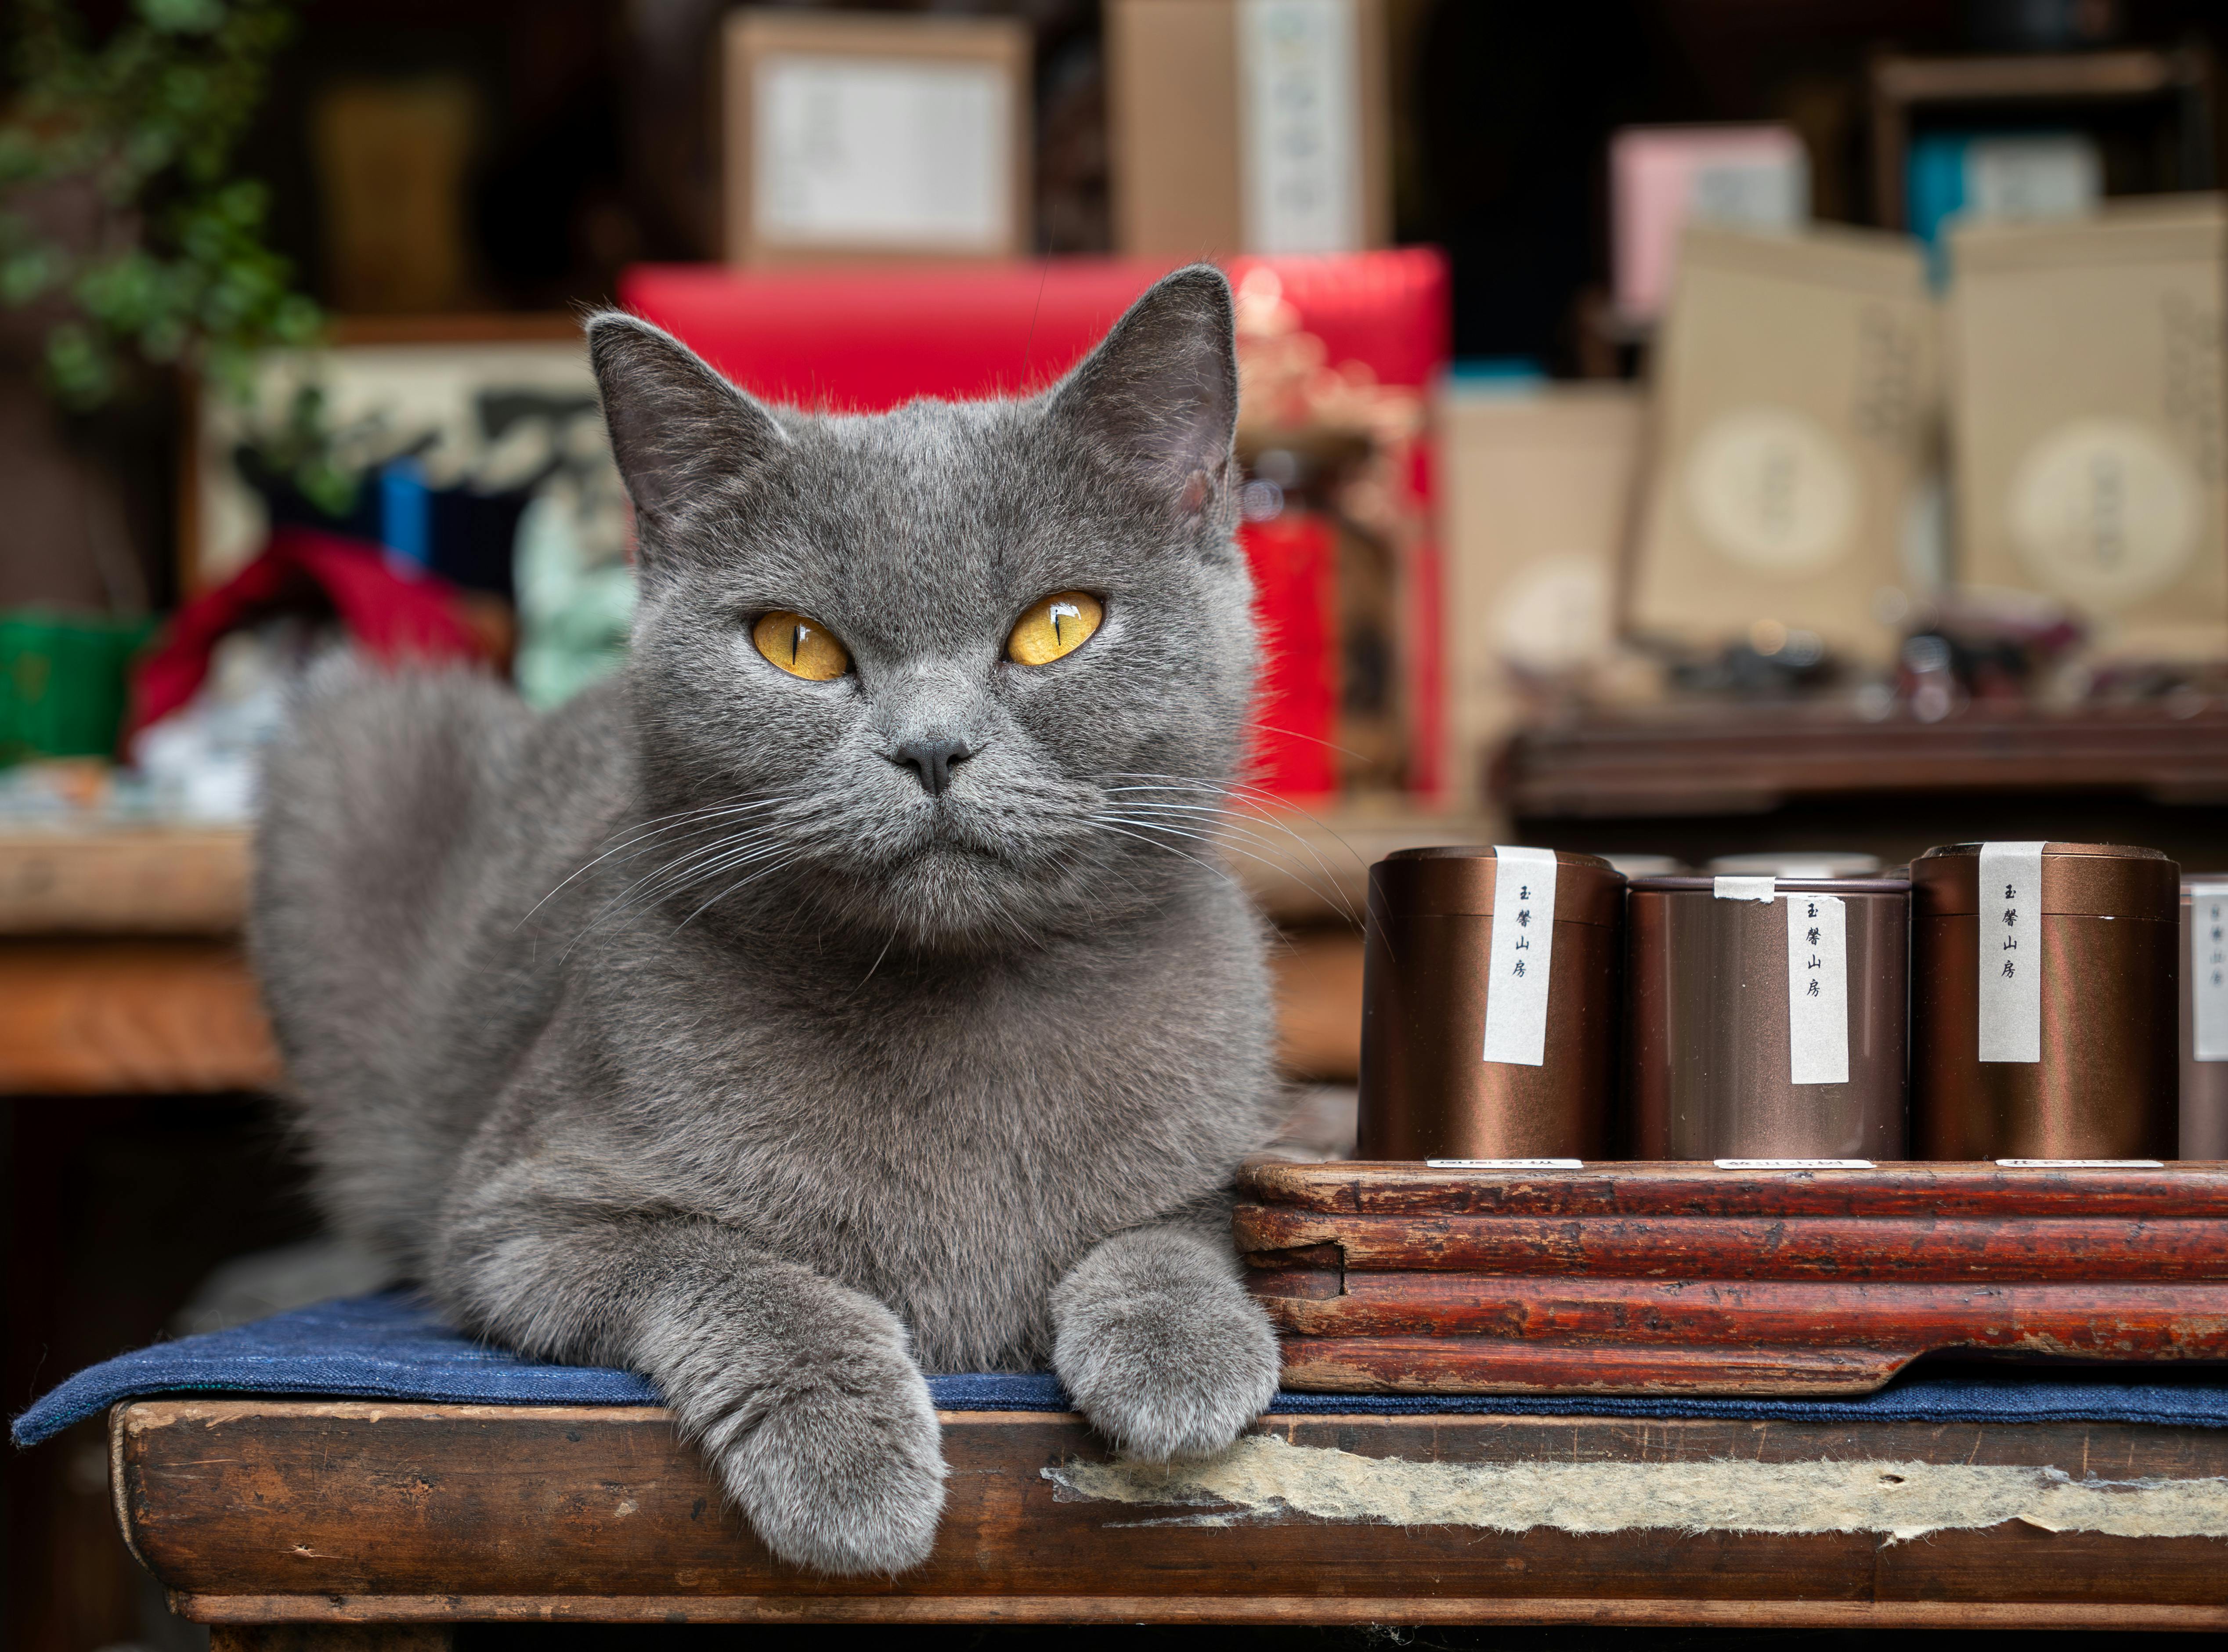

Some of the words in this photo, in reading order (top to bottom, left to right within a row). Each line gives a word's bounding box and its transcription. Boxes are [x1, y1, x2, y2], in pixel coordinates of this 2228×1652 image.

[1512, 886, 1531, 978] 玉馨山房
[1806, 903, 1821, 997] 玉馨山房
[2001, 884, 2018, 978] 玉馨山房
